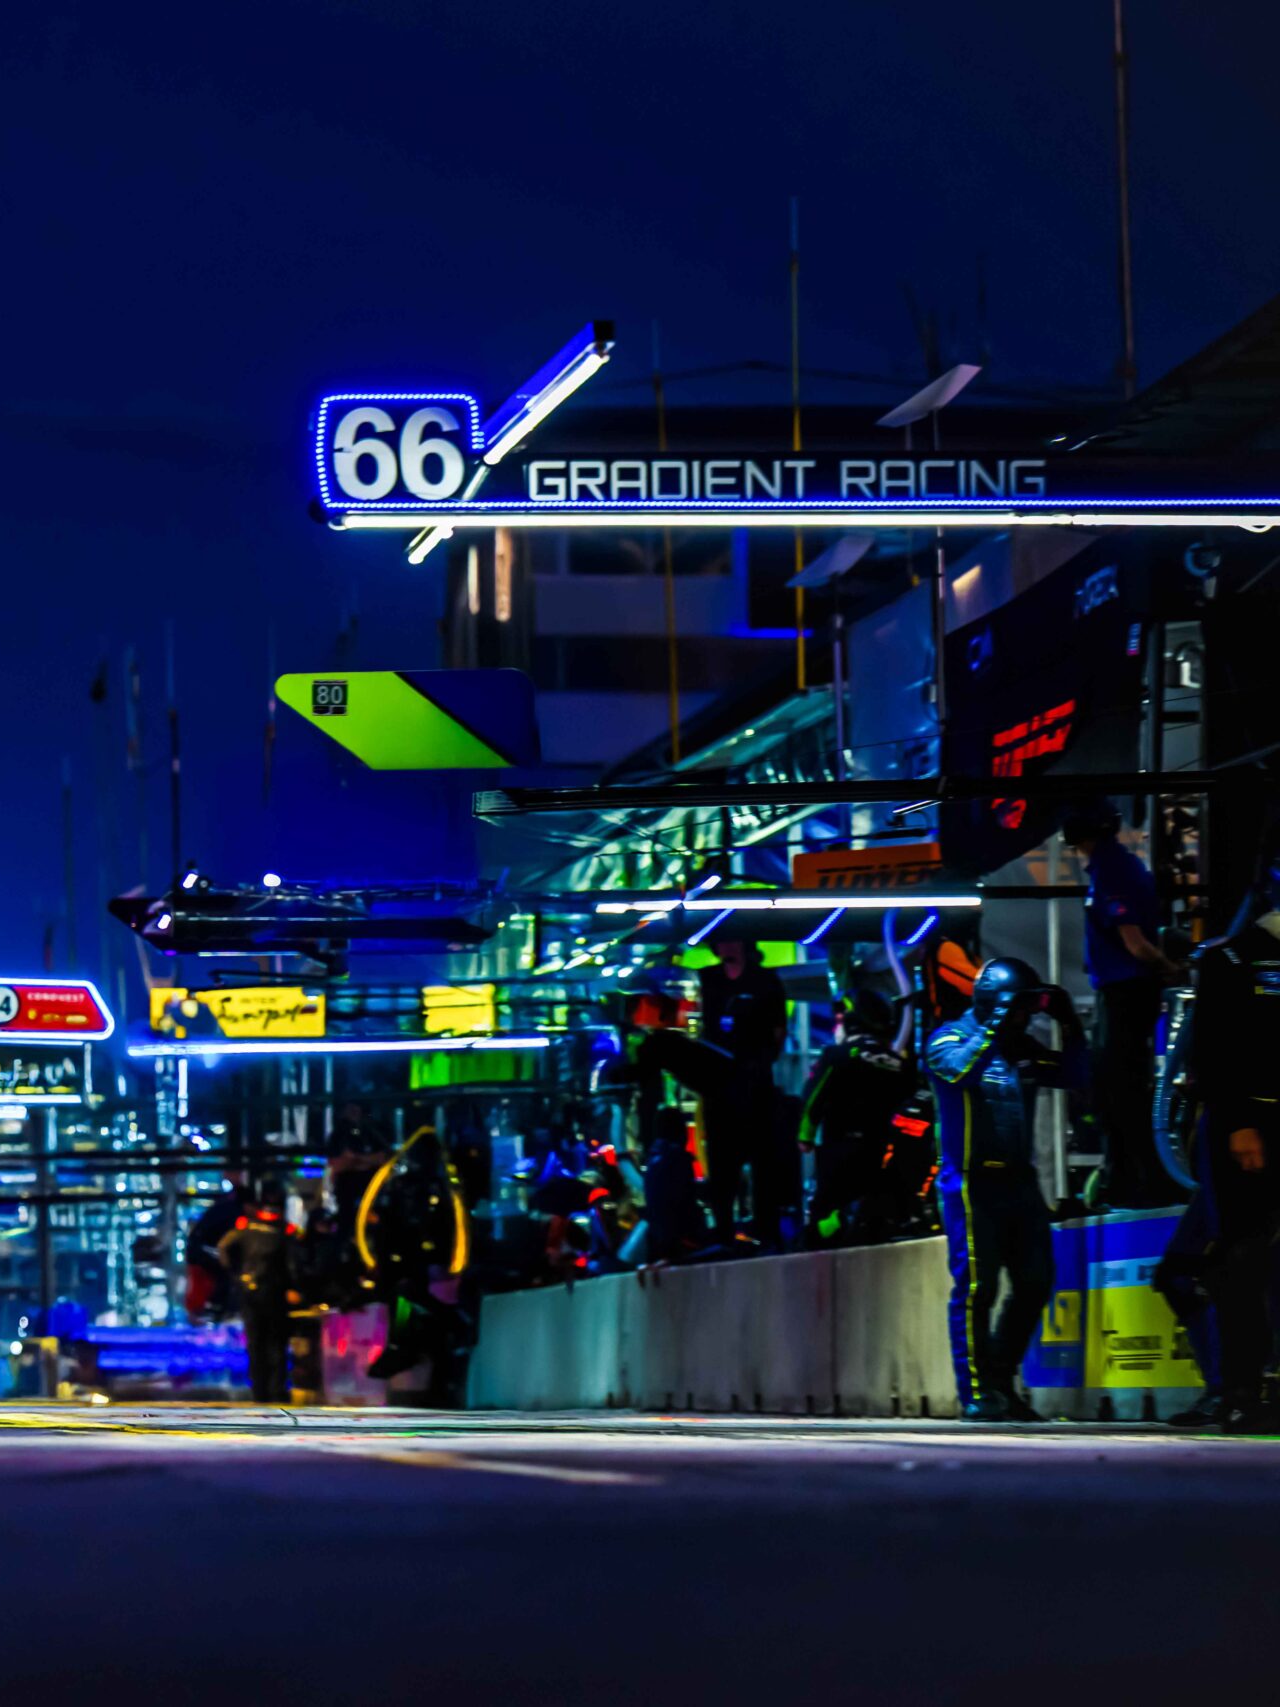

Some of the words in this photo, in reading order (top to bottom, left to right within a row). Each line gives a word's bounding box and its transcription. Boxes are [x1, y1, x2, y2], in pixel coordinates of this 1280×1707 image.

[333, 407, 465, 501] 66
[528, 460, 816, 501] GRADIENT
[839, 459, 1047, 500] RACING
[316, 685, 344, 705] 80
